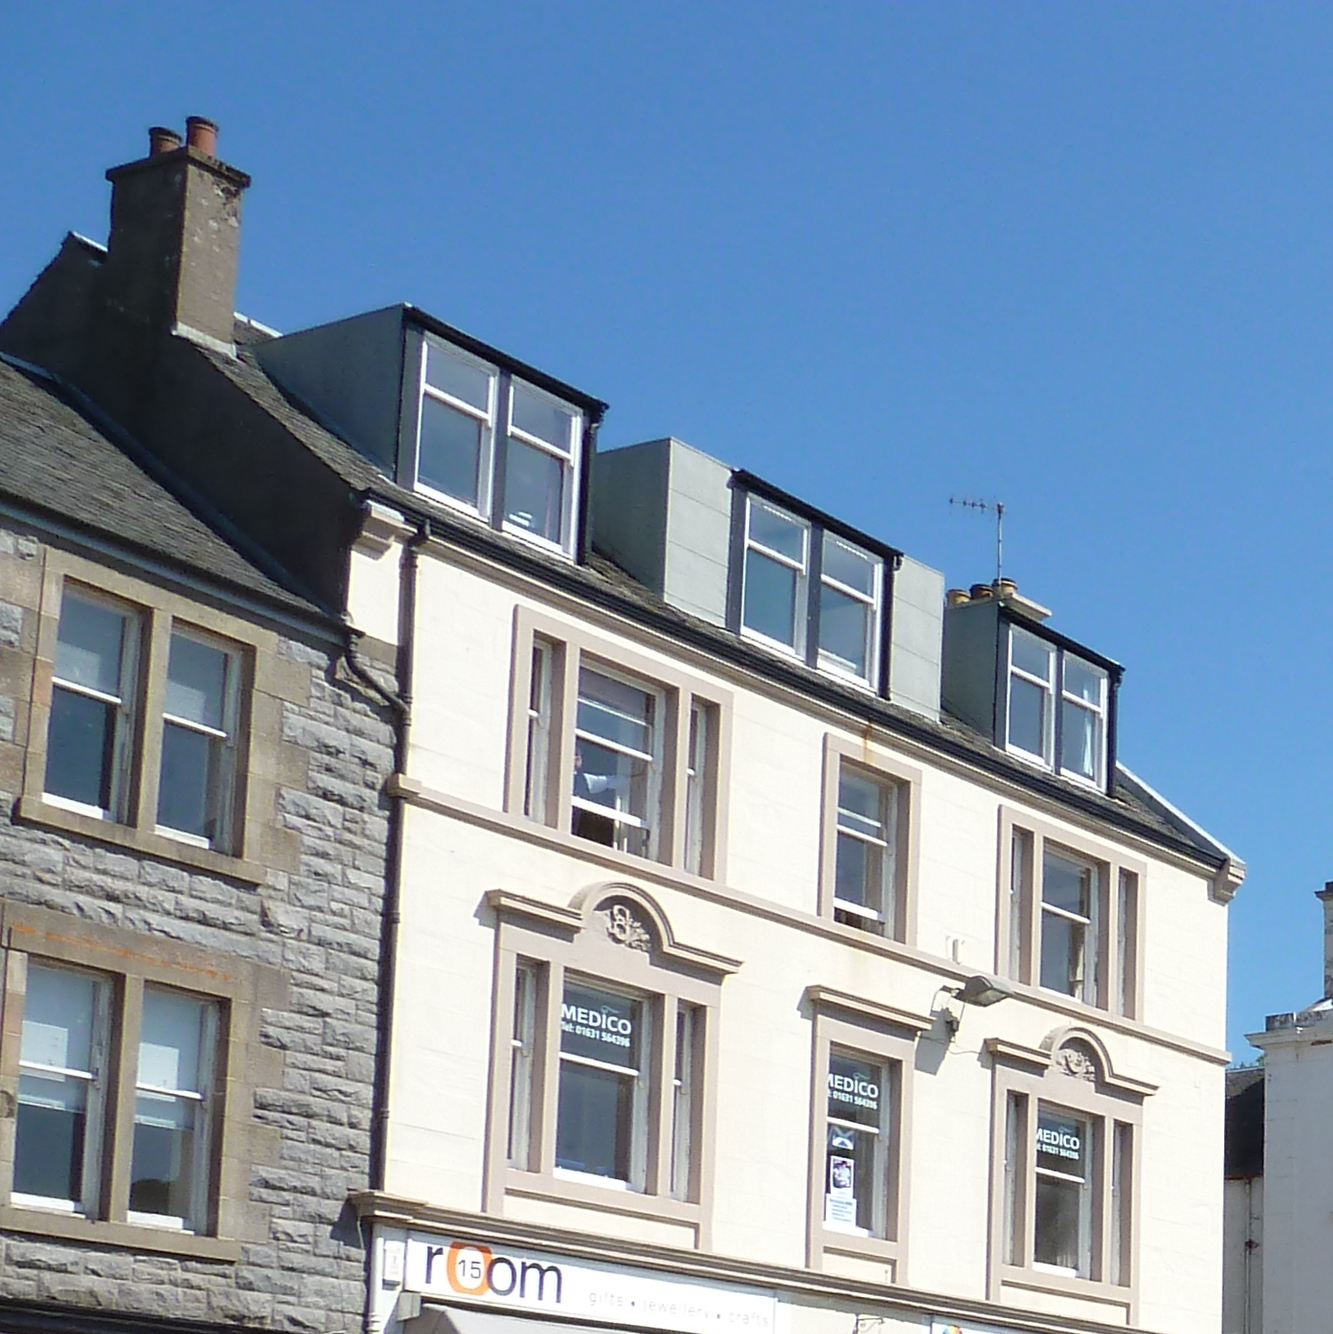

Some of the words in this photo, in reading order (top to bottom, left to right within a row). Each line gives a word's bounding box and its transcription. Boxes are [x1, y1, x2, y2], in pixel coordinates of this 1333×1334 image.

[561, 1003, 632, 1034] MEDICO
[425, 1241, 563, 1304] room
[458, 1259, 482, 1280] 15
